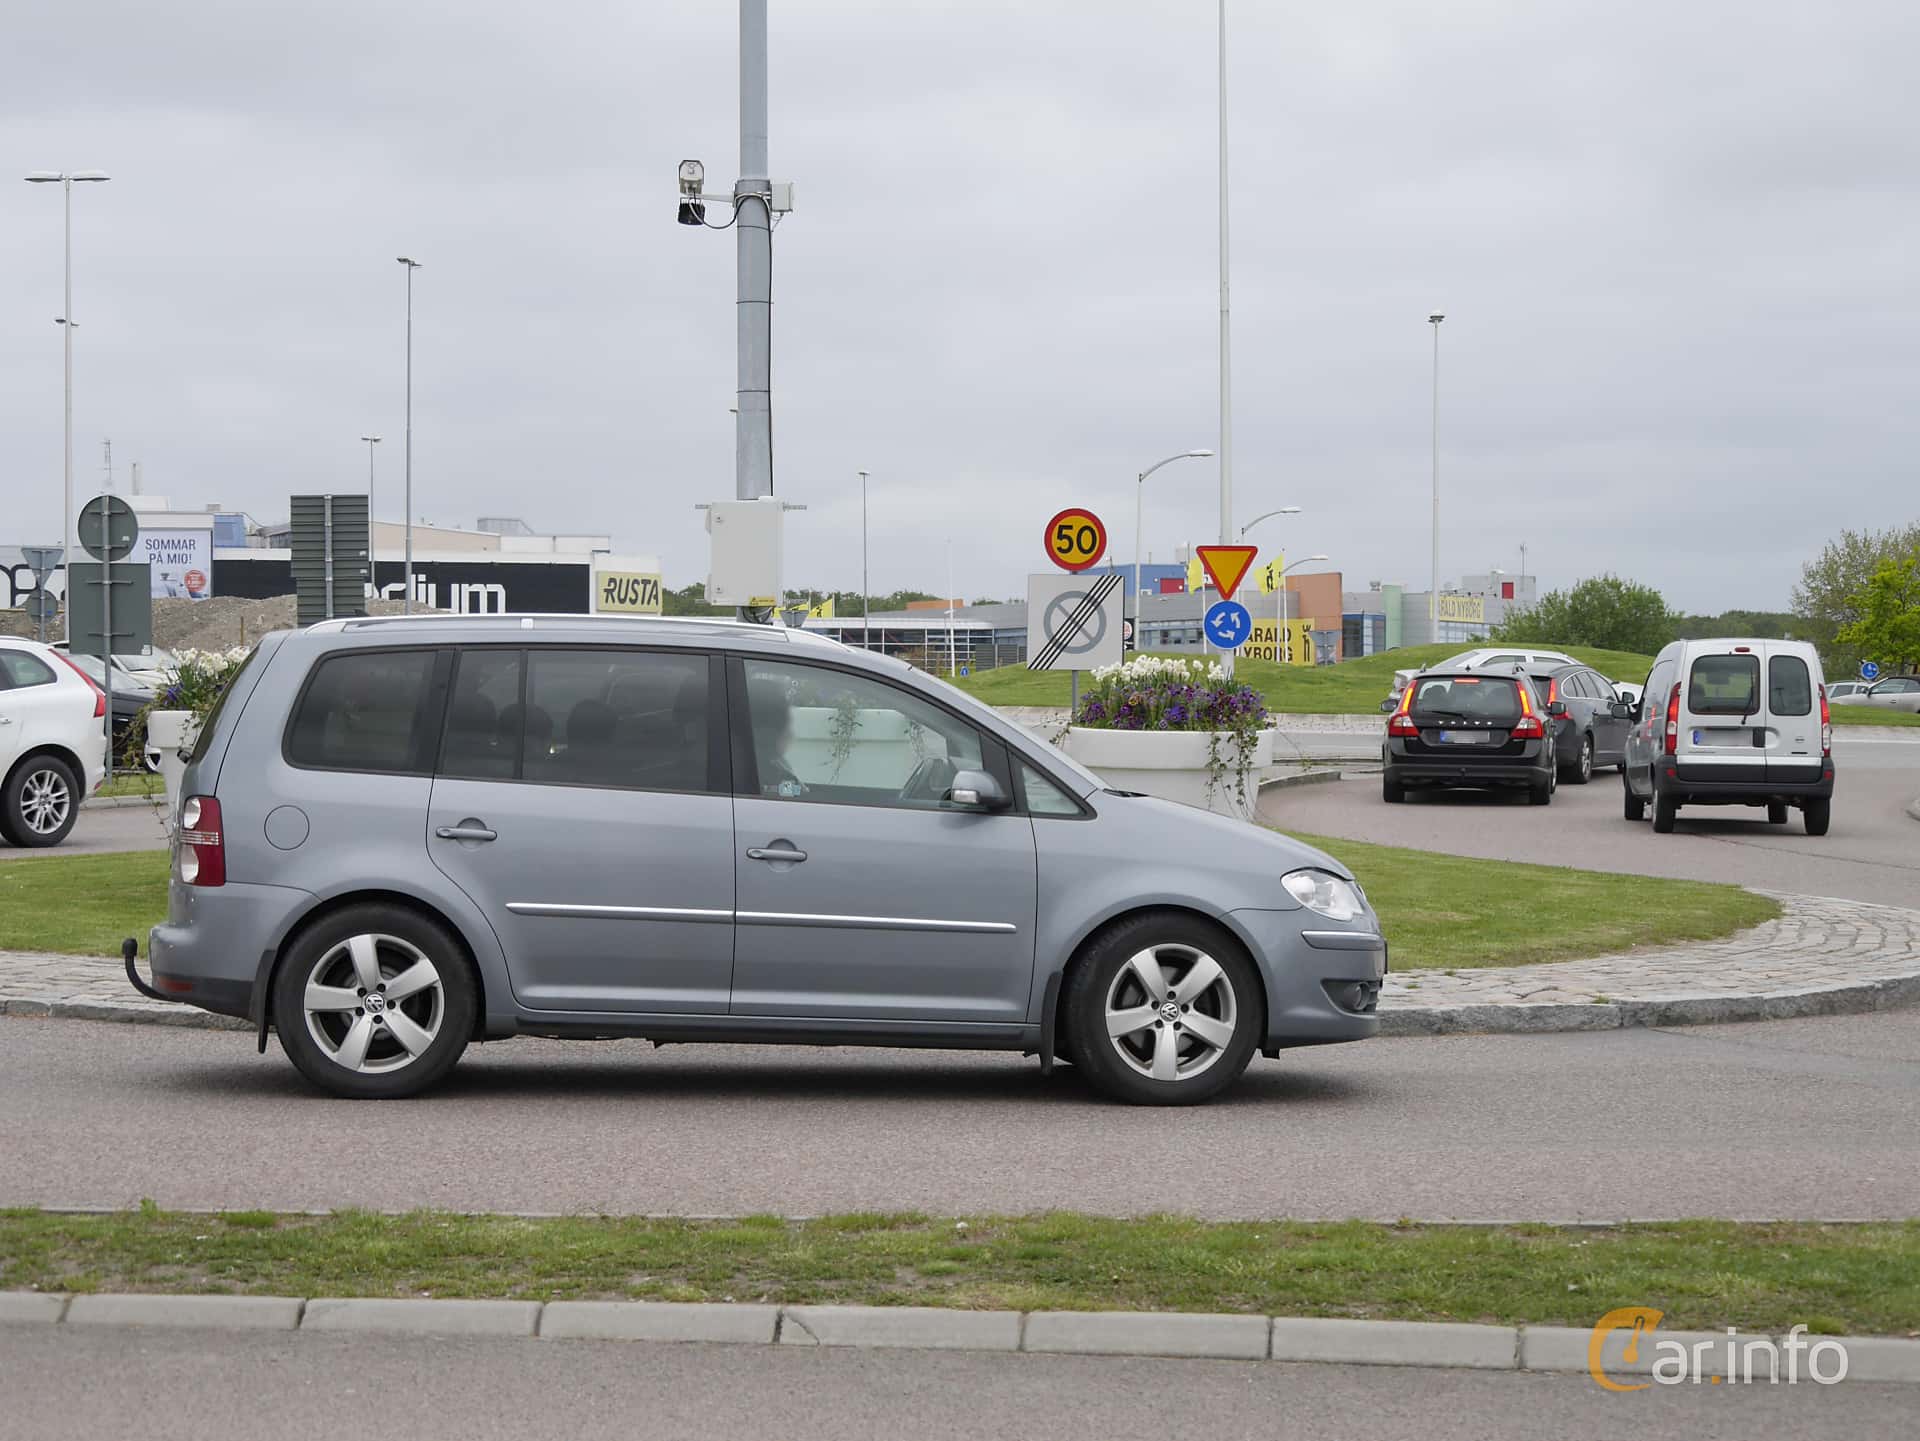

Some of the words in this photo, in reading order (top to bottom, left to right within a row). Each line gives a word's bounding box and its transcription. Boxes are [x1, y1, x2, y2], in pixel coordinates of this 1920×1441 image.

[145, 538, 196, 550] SOMMAR
[1056, 524, 1097, 554] 50
[149, 551, 163, 564] PÅ
[167, 553, 192, 564] MIO!
[603, 577, 658, 606] RUSTA
